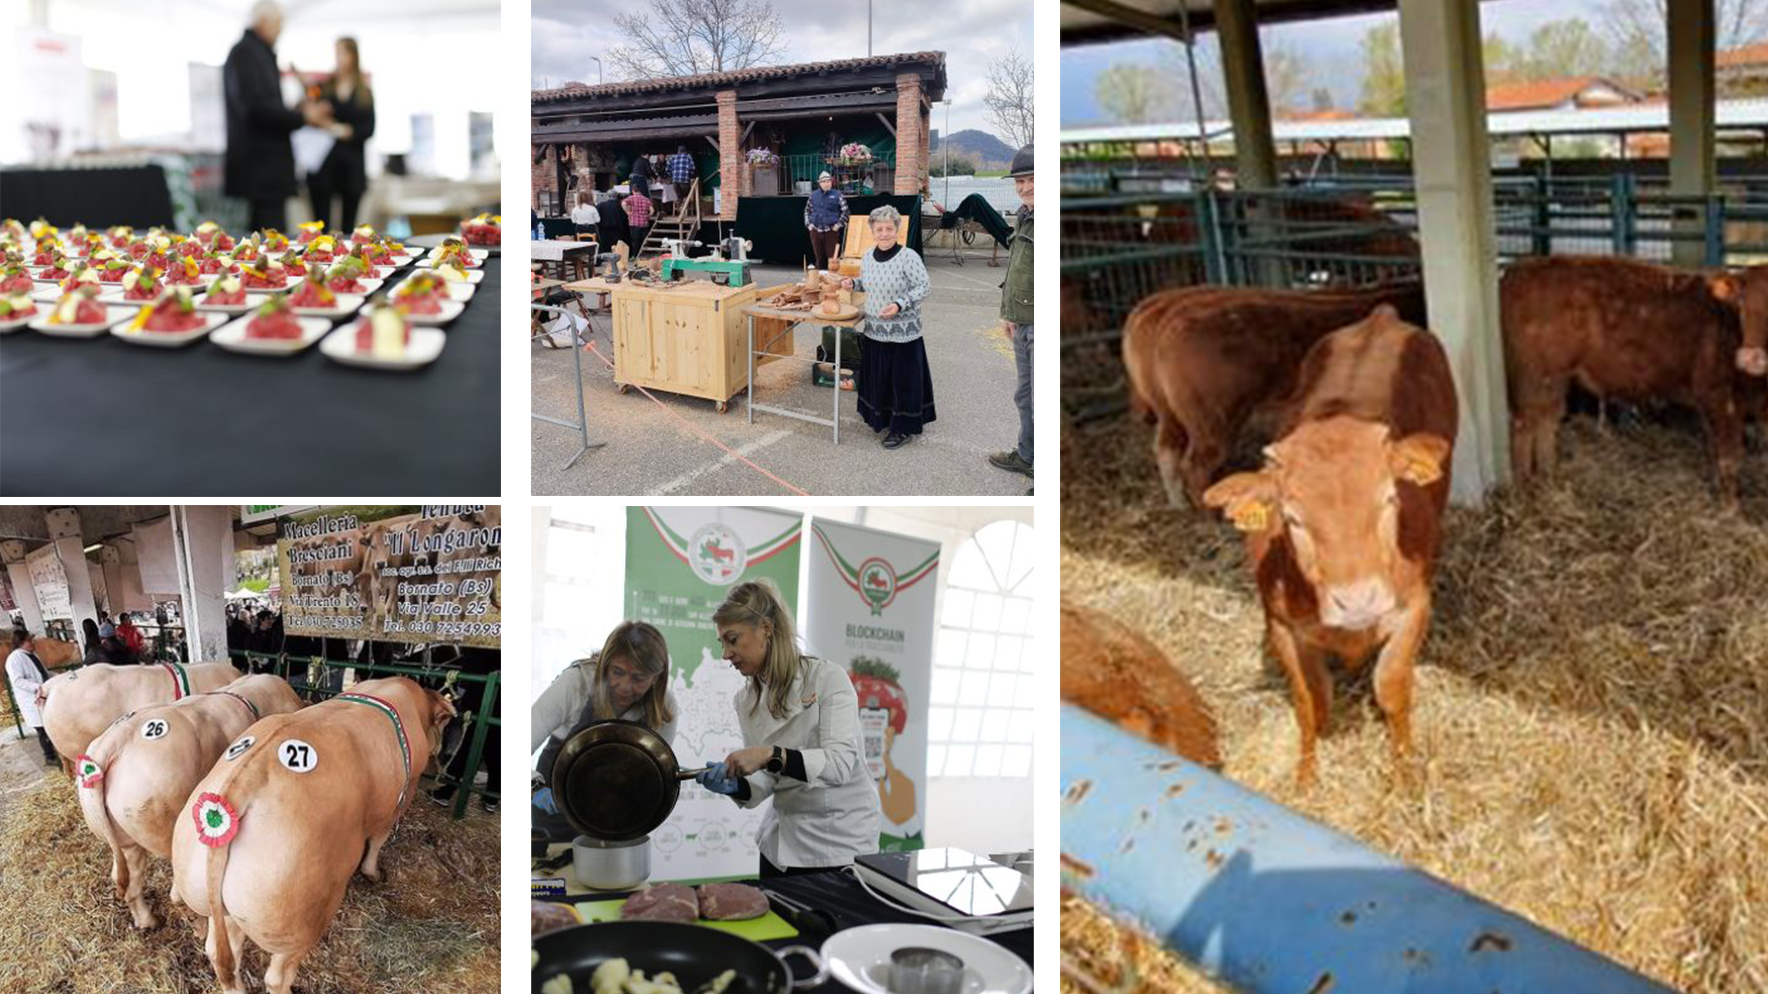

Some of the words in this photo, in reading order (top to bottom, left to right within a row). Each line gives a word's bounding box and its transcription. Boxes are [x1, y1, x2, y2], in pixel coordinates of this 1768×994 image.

[285, 512, 358, 539] Macelleria
[289, 540, 353, 564] Bresciani
[398, 581, 453, 595] Bornato
[398, 601, 420, 614] Via
[423, 602, 461, 615] Valle
[466, 600, 488, 615] 25
[409, 621, 432, 633] 030
[436, 622, 501, 637] 7254993
[846, 623, 905, 642] BLOCKCHAIN
[145, 721, 164, 737] 26
[286, 744, 309, 768] 27
